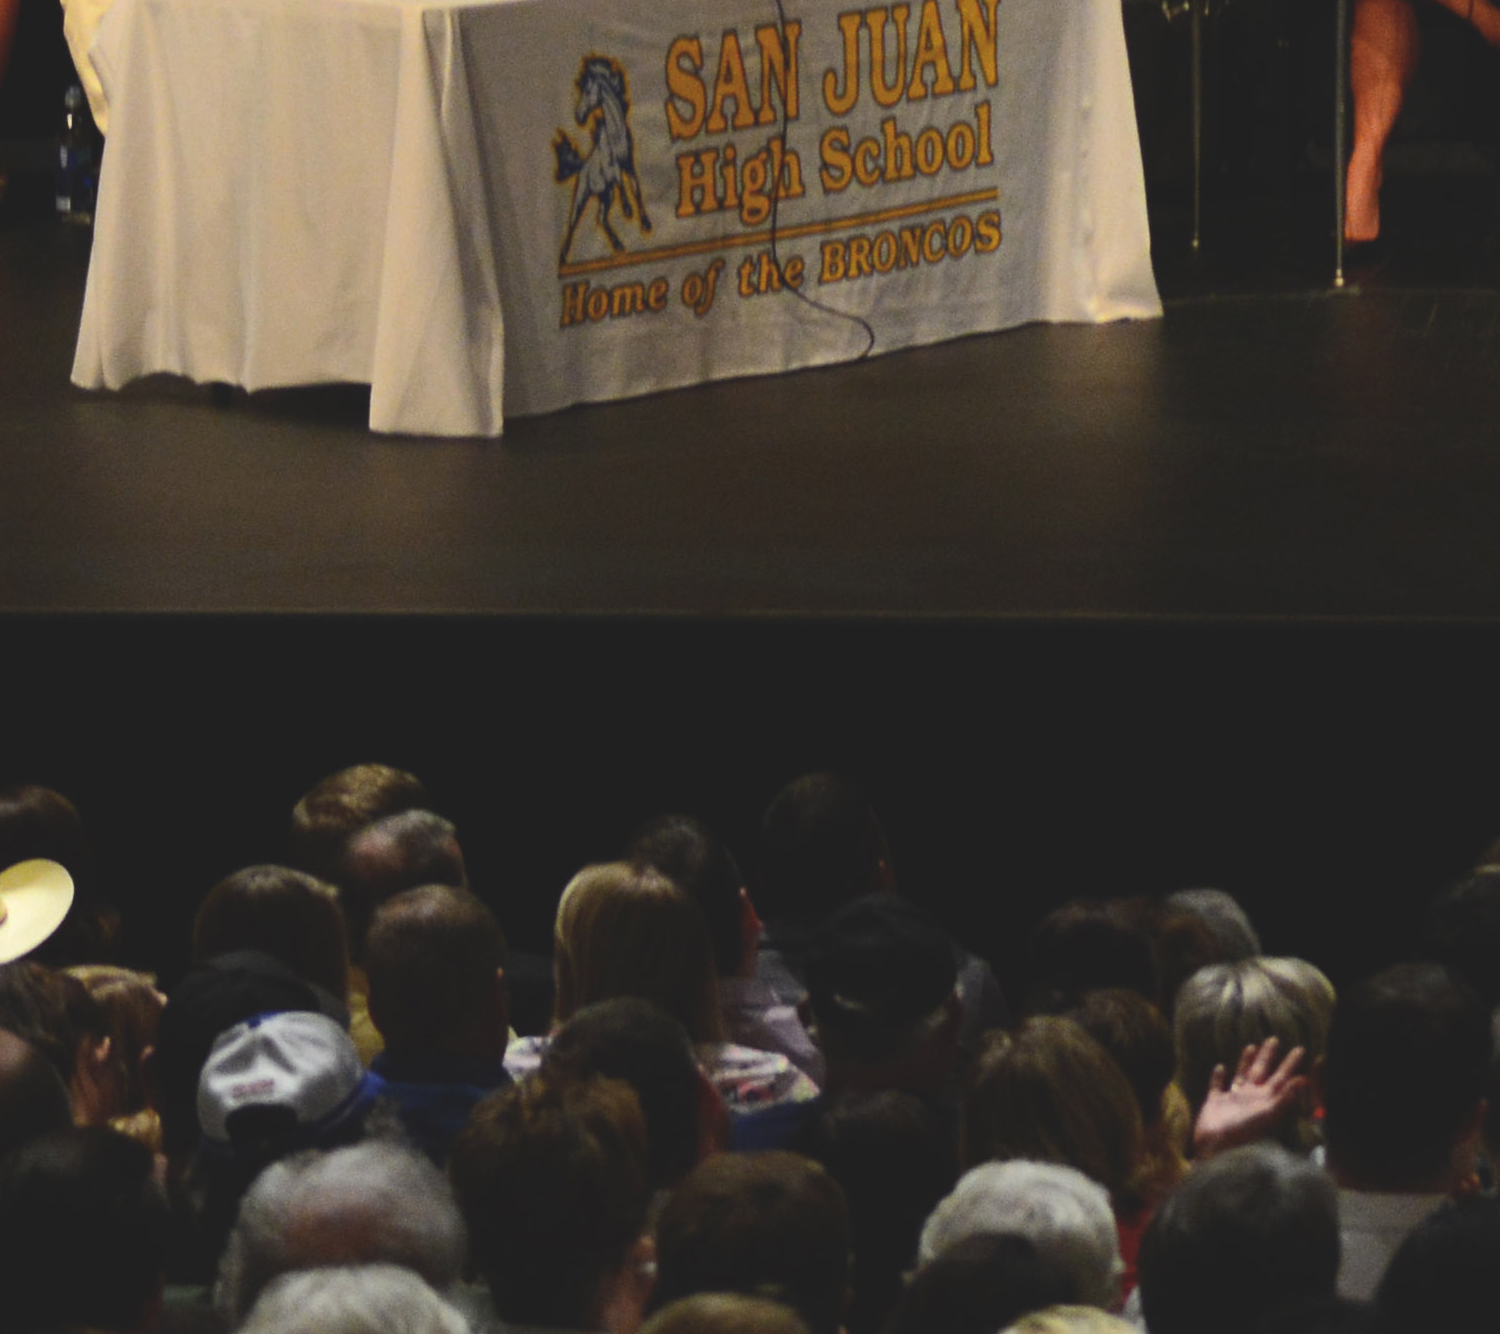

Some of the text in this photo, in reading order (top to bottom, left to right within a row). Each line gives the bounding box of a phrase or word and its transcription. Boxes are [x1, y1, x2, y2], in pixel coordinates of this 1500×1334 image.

[663, 18, 803, 142] SAN
[674, 101, 995, 226] High School
[559, 208, 1003, 329] Home of the BRONCOS
